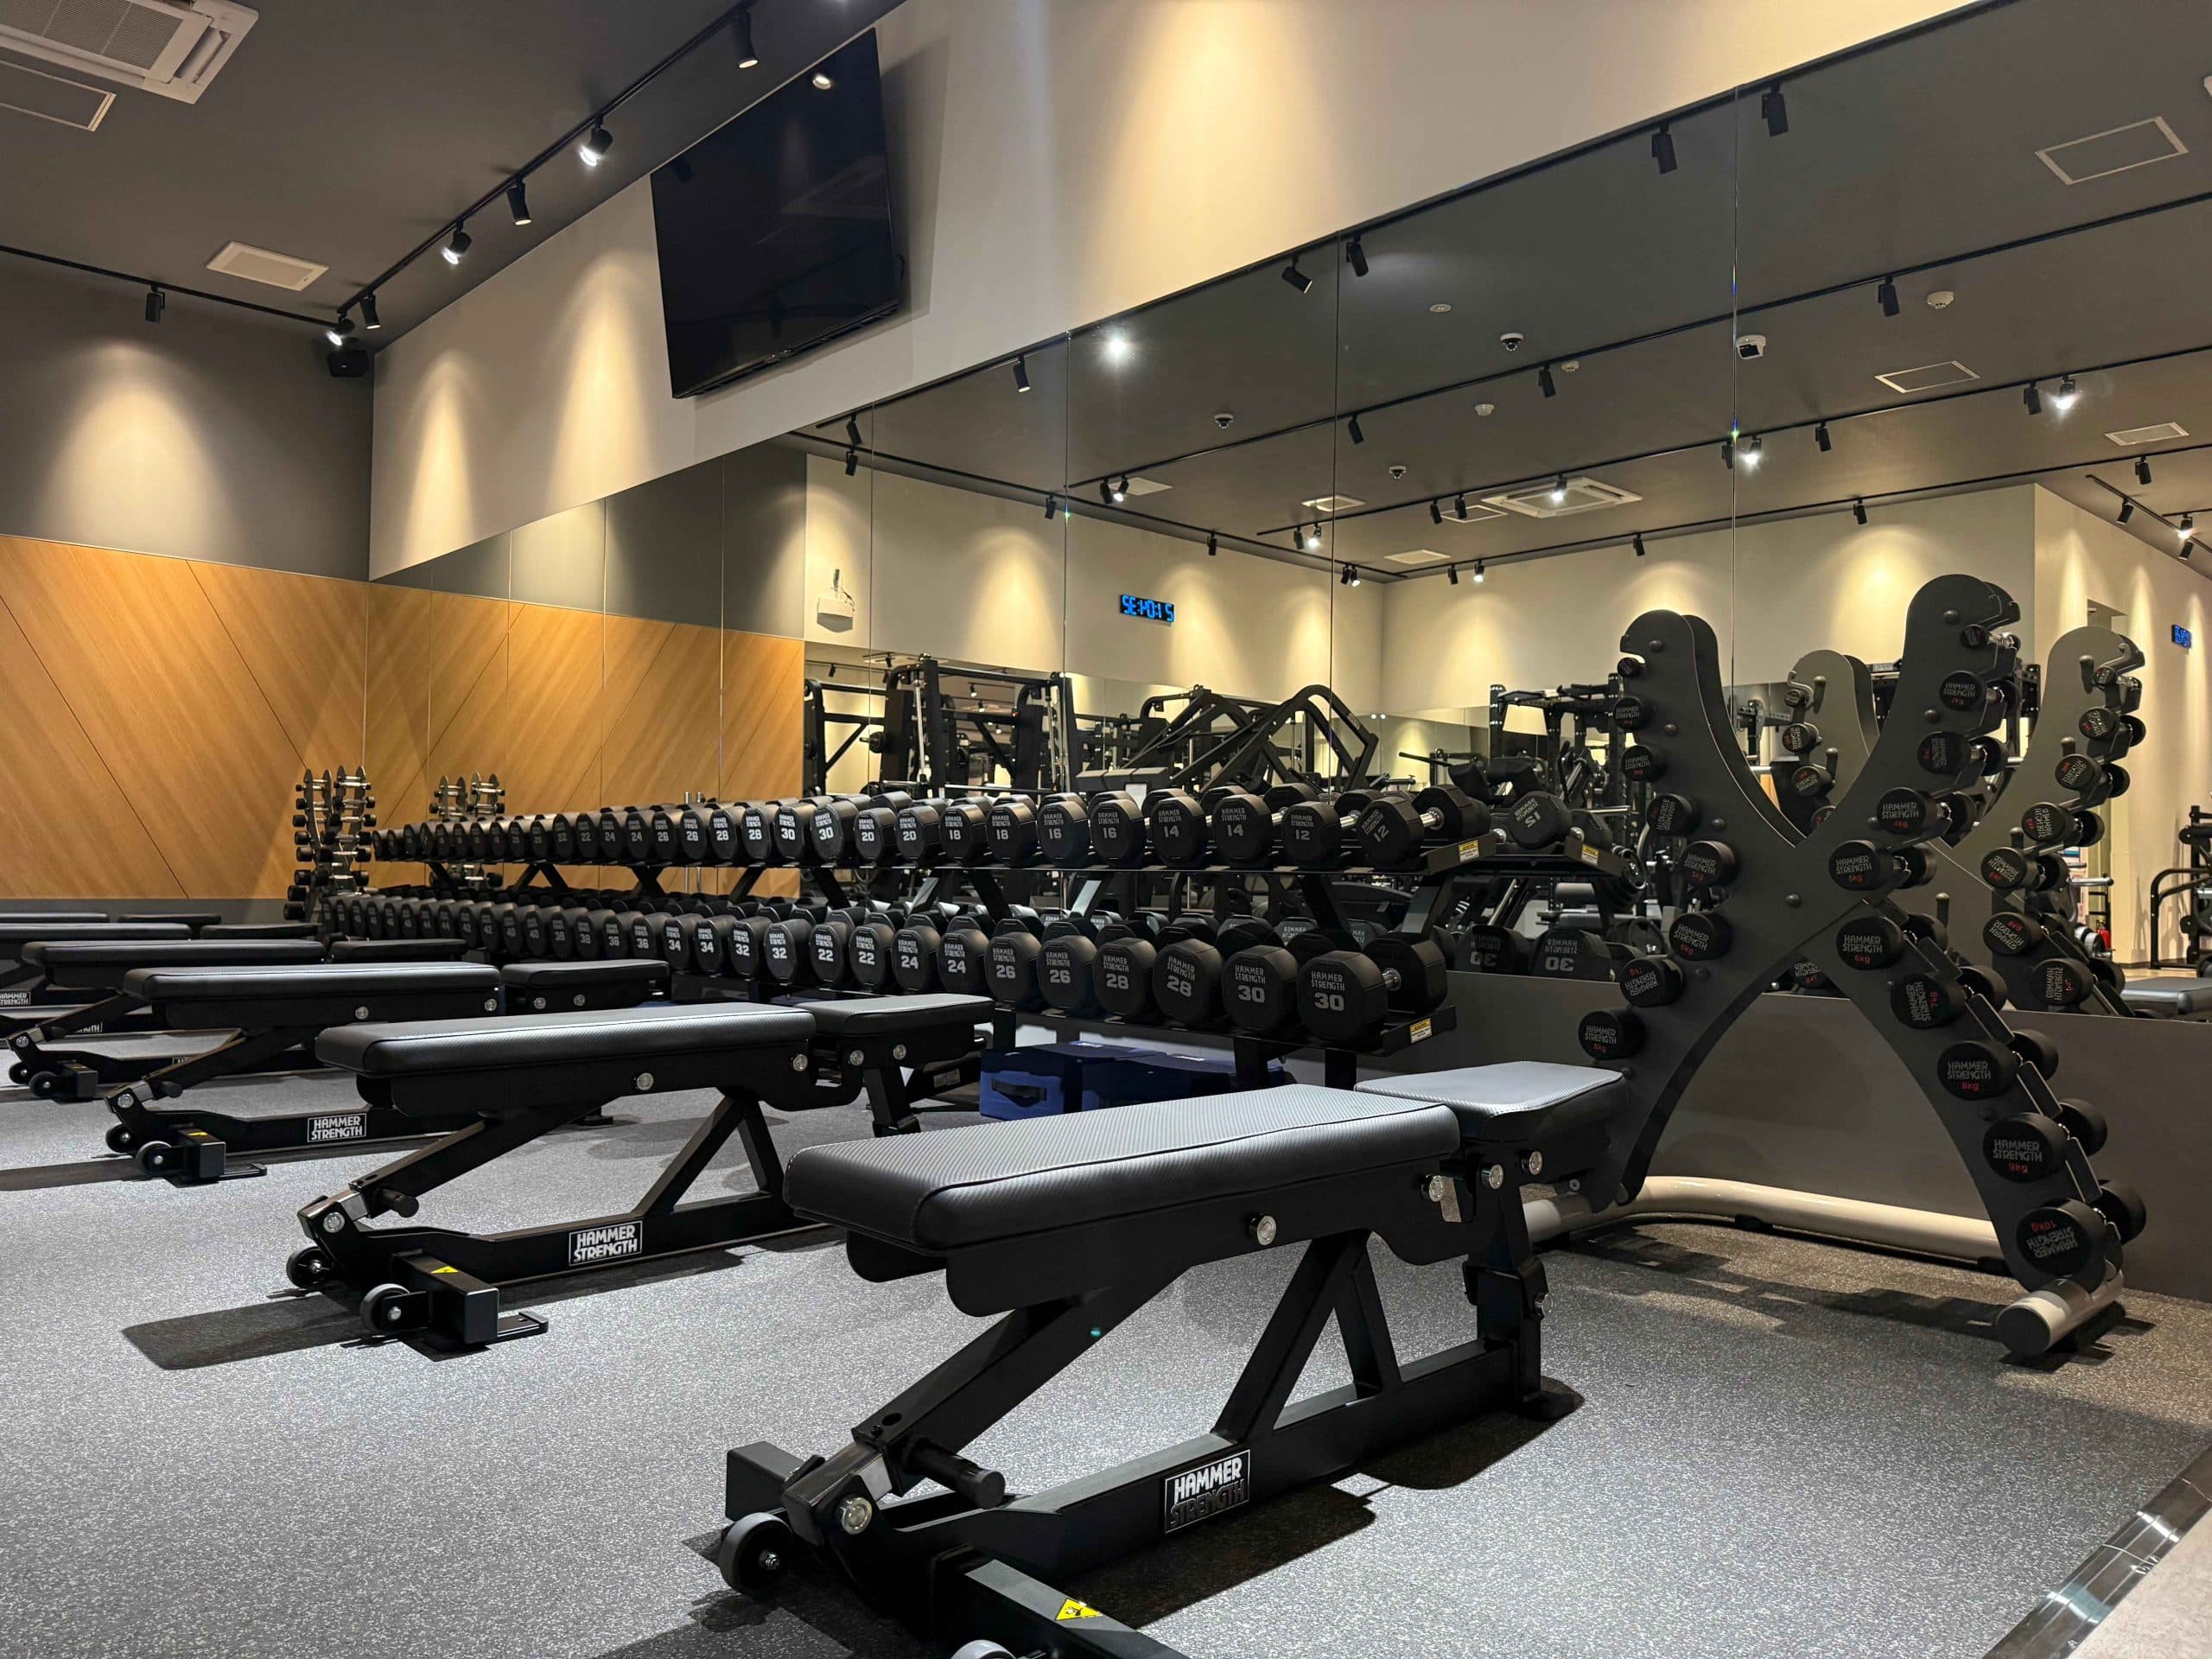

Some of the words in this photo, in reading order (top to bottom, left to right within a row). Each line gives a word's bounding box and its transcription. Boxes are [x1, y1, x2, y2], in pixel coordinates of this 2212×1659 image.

[1882, 801, 1917, 811] HAMMER
[1881, 810, 1919, 820] STRENGTH
[715, 830, 728, 841] 28
[748, 829, 762, 840] 28
[781, 828, 795, 840] 30
[818, 827, 834, 841] 30
[902, 830, 917, 842] 20
[949, 830, 961, 840] 18
[996, 829, 1008, 840] 18
[1049, 828, 1062, 839] 16
[1103, 827, 1117, 838] 16
[1164, 825, 1179, 837] 14
[1227, 824, 1244, 836] 14
[1295, 830, 1311, 841] 12
[605, 831, 615, 842] 24
[631, 831, 642, 842] 24
[861, 831, 874, 842] 20
[1835, 855, 1869, 866] HAMMER
[1835, 863, 1872, 875] STRENGTH
[1677, 924, 1709, 941] HAMMER
[668, 939, 681, 951] 34
[1674, 931, 1708, 951] STRENGTH
[1843, 934, 1881, 944] HAMMER
[701, 942, 714, 953] 34
[735, 944, 750, 957] 32
[772, 947, 787, 959] 32
[1841, 944, 1883, 954] STRENGTH
[817, 949, 834, 962] 22
[858, 951, 875, 965] 22
[1046, 951, 1068, 960] HAMMER
[1103, 954, 1128, 965] HAMMER
[900, 955, 919, 969] 24
[948, 959, 966, 974] 24
[1046, 958, 1071, 967] STRENGTH
[1103, 962, 1129, 973] STRENGTH
[1168, 955, 1196, 972] HAMMER
[996, 964, 1015, 979] 26
[1049, 969, 1071, 983] 26
[1166, 963, 1196, 982] STRENGTH
[1235, 964, 1264, 976] HAMMER
[1106, 973, 1129, 989] 28
[1235, 973, 1266, 984] STRENGTH
[1311, 971, 1344, 982] HAMMER
[1166, 976, 1192, 997] 28
[1311, 979, 1345, 991] STRENGTH
[1237, 985, 1266, 1003] 30
[1314, 992, 1344, 1012] 30
[1905, 983, 1921, 1021] HAMMER
[1914, 981, 1931, 1021] STRENGTH
[1586, 1025, 1617, 1036] HAMMER
[1584, 1033, 1618, 1045] STRENGTH
[1948, 1060, 1988, 1071] HAMMER
[1947, 1070, 1991, 1079] STRENGTH
[314, 1116, 361, 1129] HAMMER
[311, 1126, 363, 1141] STRENGTH
[1993, 1138, 2040, 1151] HAMMER
[1993, 1148, 2043, 1162] STRENGTH
[576, 1224, 635, 1248] HAMMER
[2025, 1226, 2072, 1249] STRENGTH
[573, 1237, 638, 1262] STRENGTH
[2034, 1238, 2080, 1259] HAMMER
[1173, 1457, 1243, 1504] HAMMER
[1170, 1478, 1246, 1526] STRENGTH
